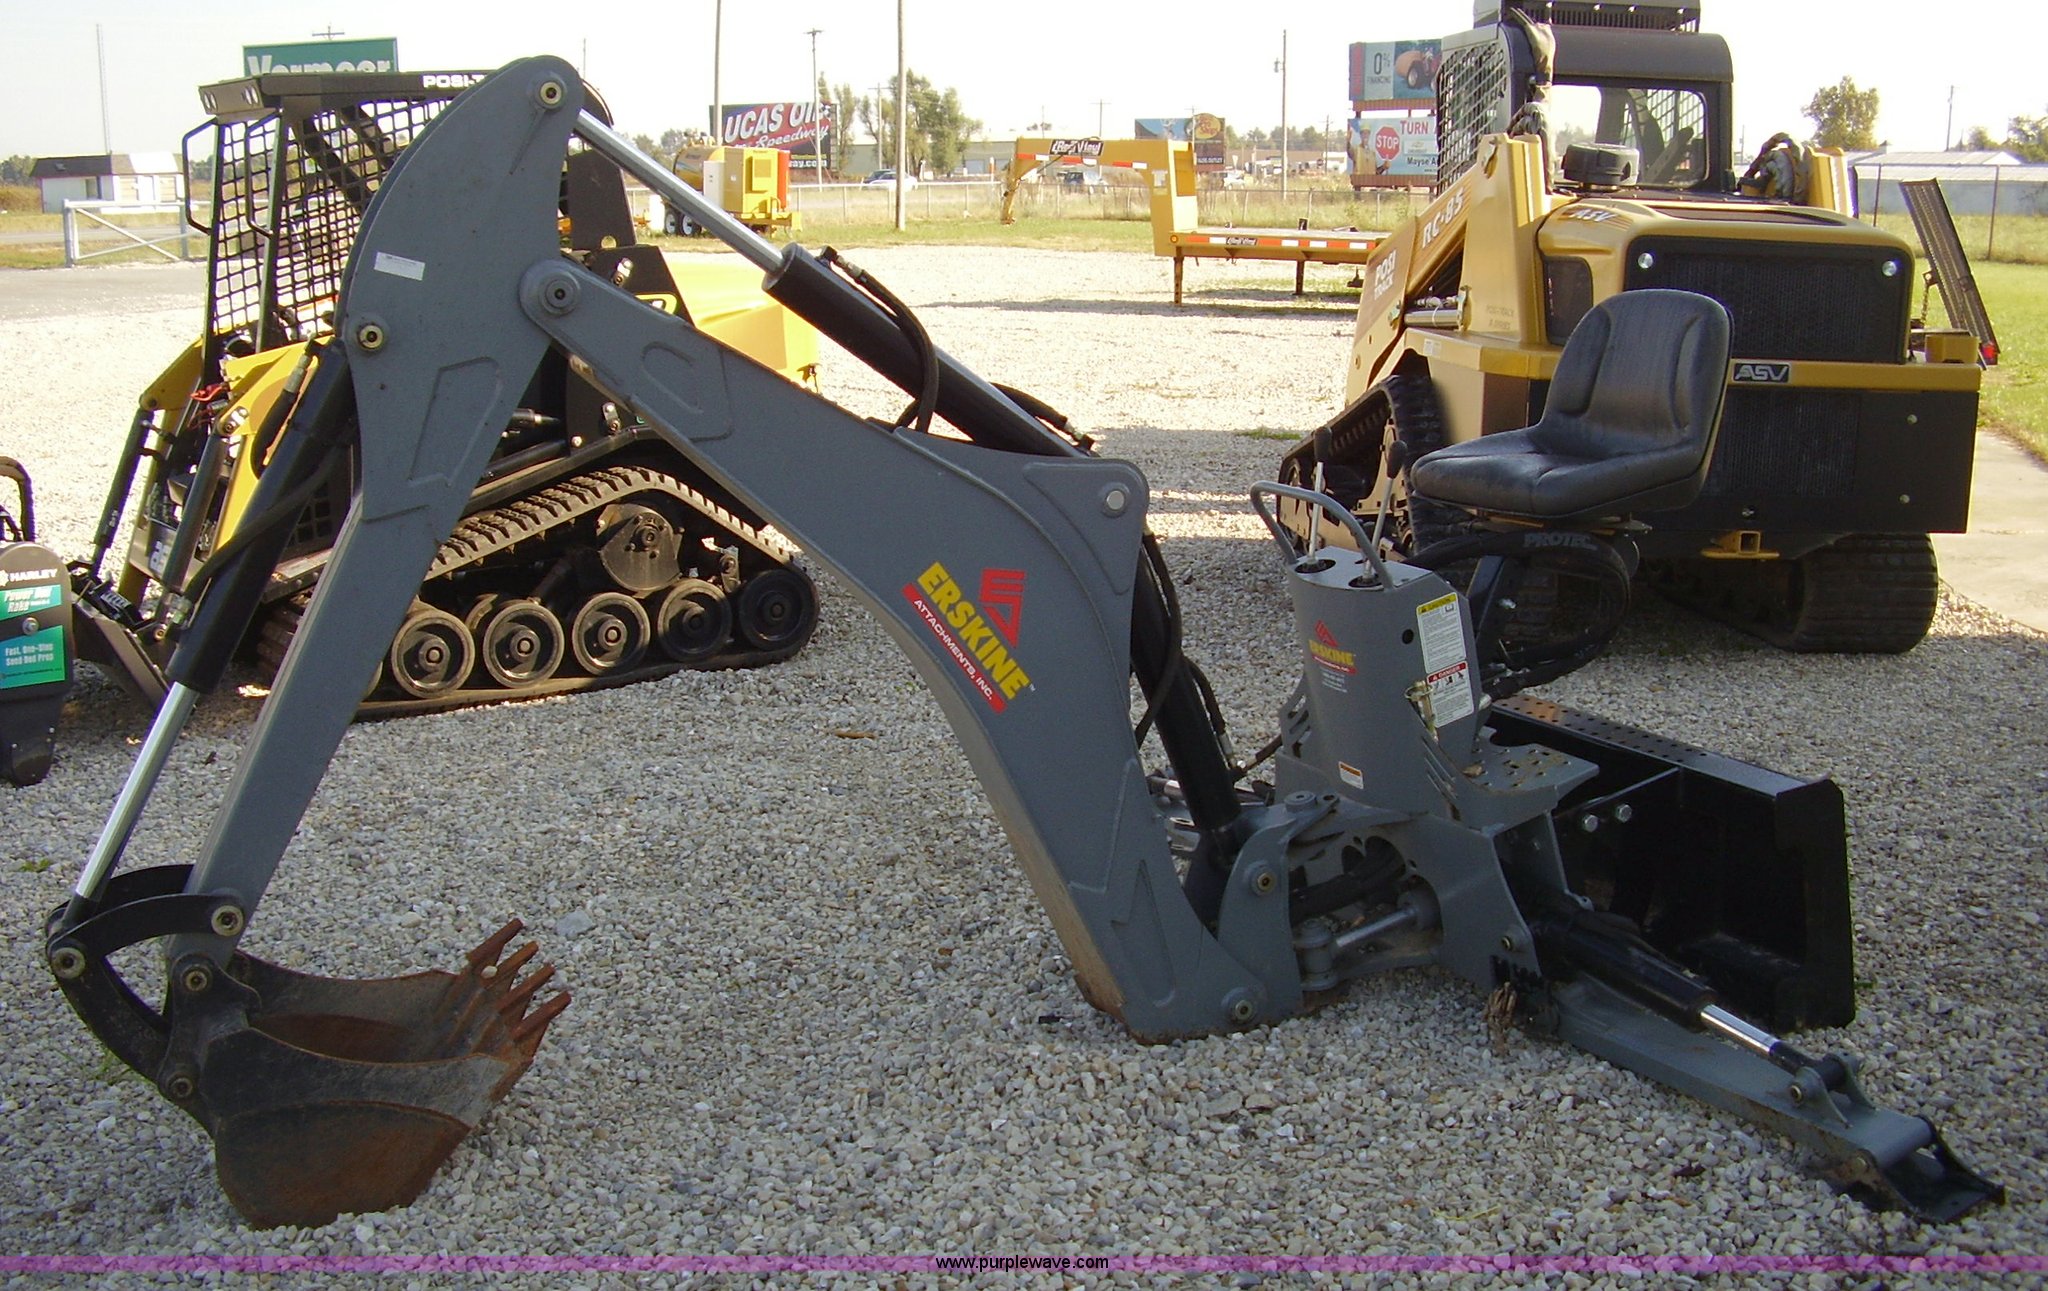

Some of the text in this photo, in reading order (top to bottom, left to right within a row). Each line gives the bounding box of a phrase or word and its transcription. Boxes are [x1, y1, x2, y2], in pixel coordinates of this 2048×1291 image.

[1400, 120, 1428, 134] TURN
[1376, 135, 1399, 149] STOP
[1569, 208, 1617, 222] ASV
[1375, 250, 1396, 287] POSI
[1734, 365, 1788, 381] ASV
[9, 569, 57, 582] HARLEY
[917, 561, 1031, 700] ERSKINE
[914, 599, 993, 700] ATTACHMENTS, INC.
[1309, 640, 1354, 666] ERSKINE
